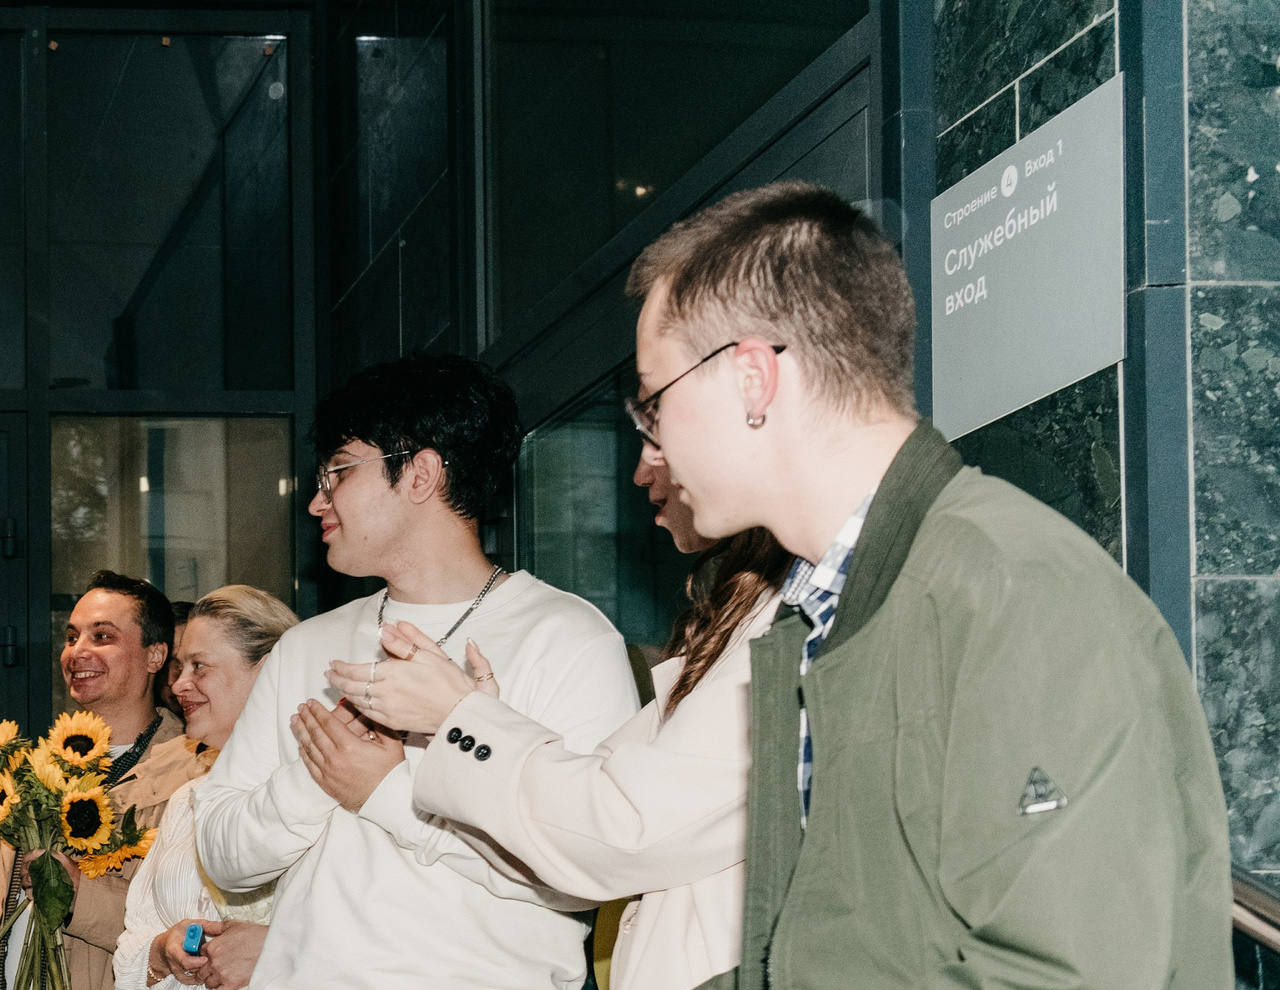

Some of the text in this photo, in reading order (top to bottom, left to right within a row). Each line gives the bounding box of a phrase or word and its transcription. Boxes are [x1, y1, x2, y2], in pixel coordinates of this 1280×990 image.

[944, 186, 998, 228] Строение
[1024, 149, 1055, 178] Вход
[1056, 139, 1063, 157] 1
[944, 181, 1058, 276] Служебный
[945, 275, 987, 316] вход
